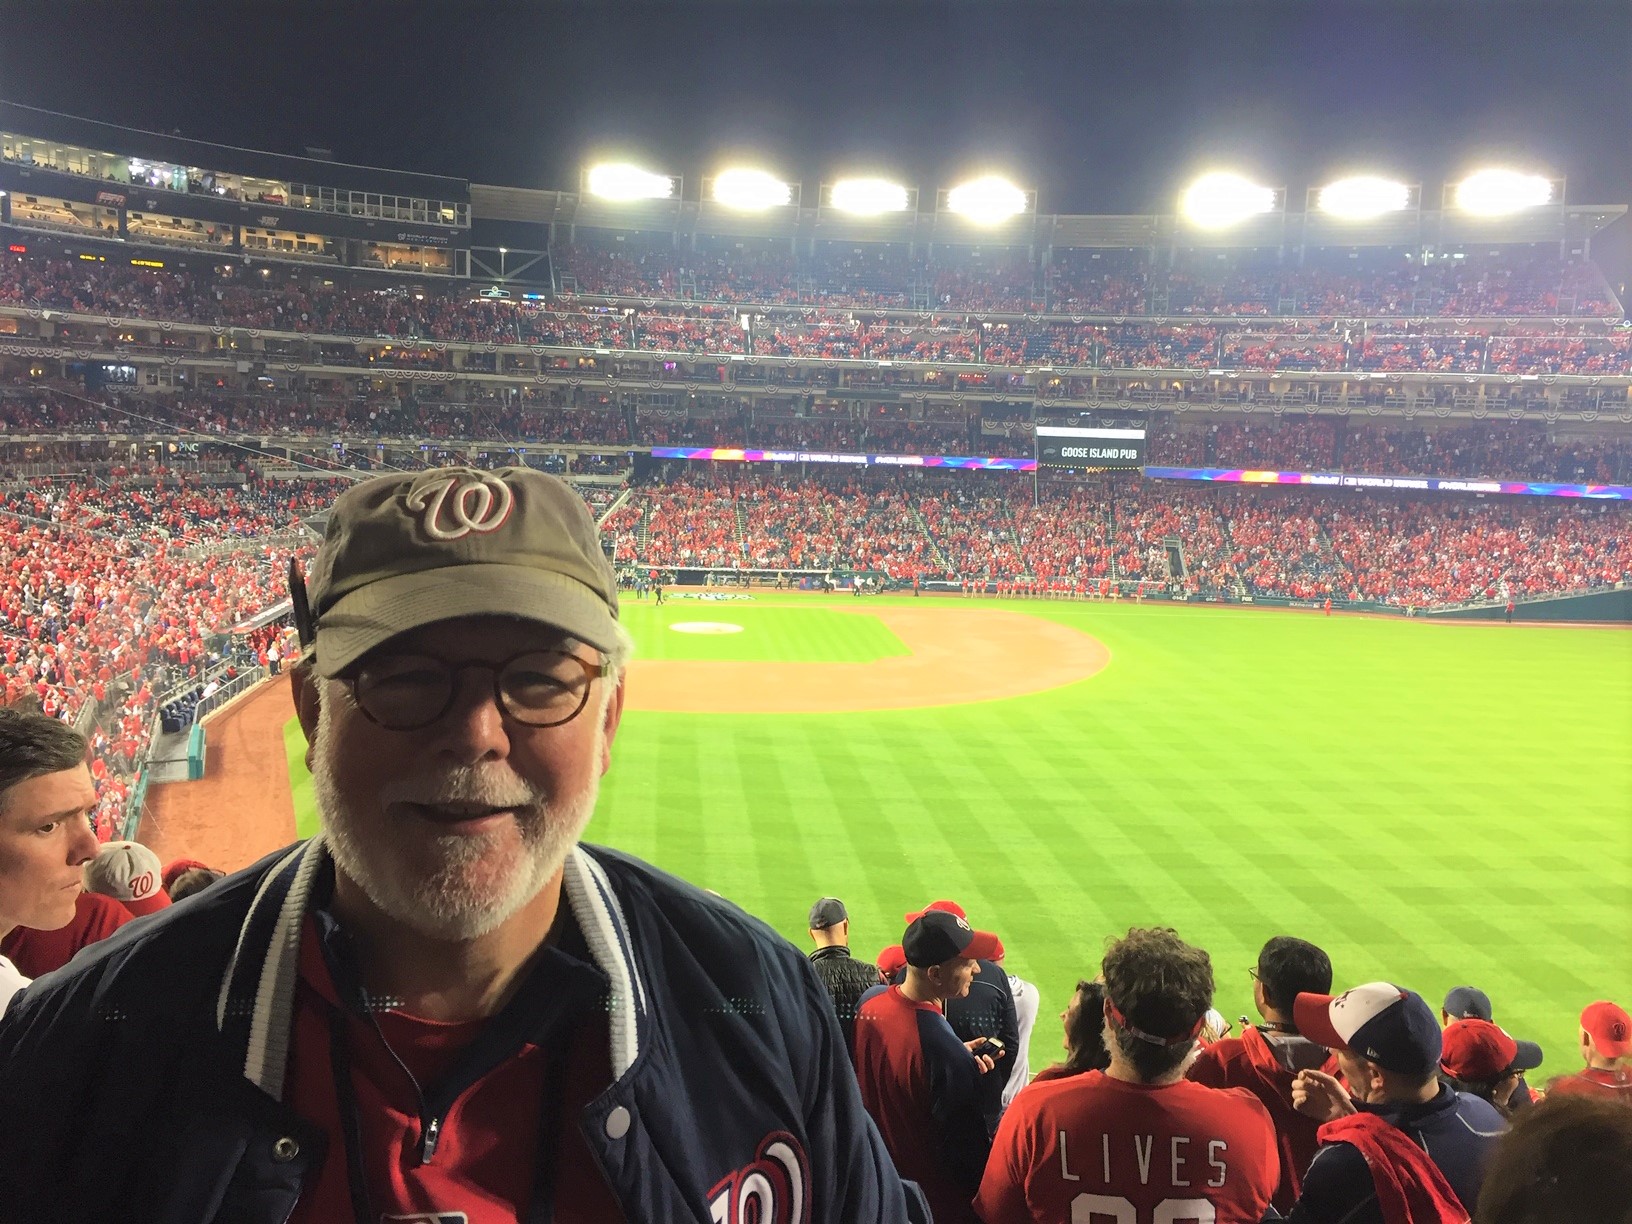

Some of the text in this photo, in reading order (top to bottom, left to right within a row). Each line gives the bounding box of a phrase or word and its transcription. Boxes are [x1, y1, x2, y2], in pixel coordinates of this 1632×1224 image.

[179, 441, 199, 452] PNC
[1061, 446, 1138, 459] GOOSE ISLAND PUB
[128, 870, 154, 899] W
[1059, 1130, 1227, 1188] LIVES
